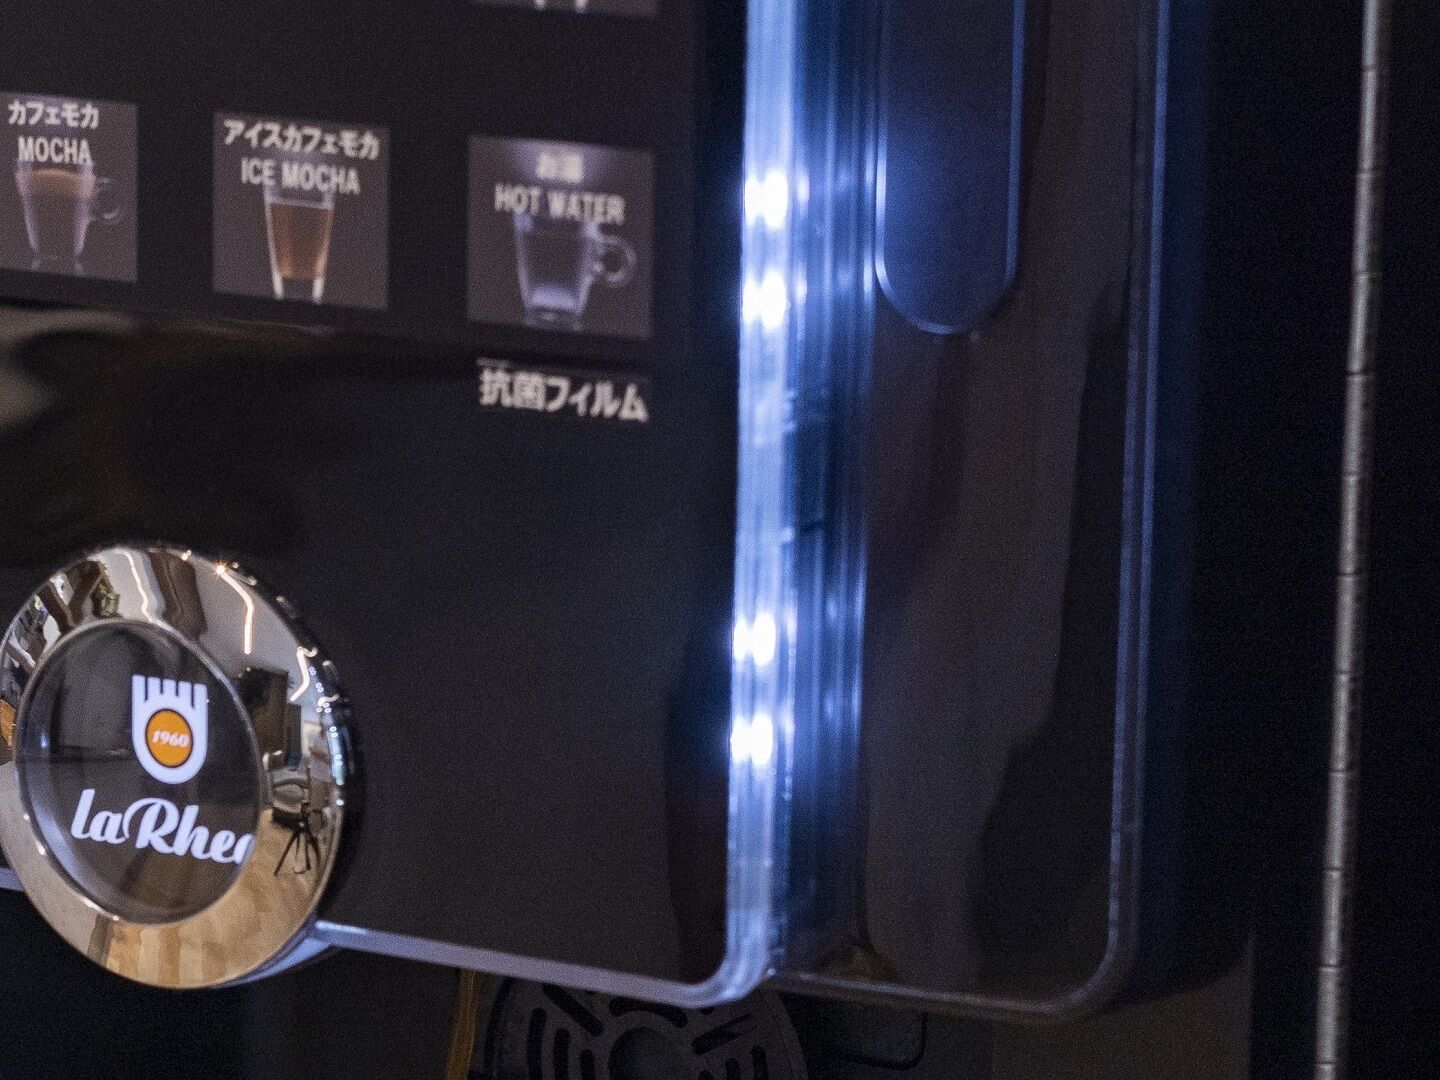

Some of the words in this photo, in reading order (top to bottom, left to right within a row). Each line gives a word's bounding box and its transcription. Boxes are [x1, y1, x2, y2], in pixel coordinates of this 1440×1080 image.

[7, 100, 100, 129] カフェモカ
[17, 136, 93, 164] MOCHA
[223, 118, 380, 160] アイスカフェモカ
[241, 157, 276, 186] ICE
[281, 161, 360, 195] MOCHA
[494, 182, 541, 214] HOT
[547, 189, 626, 225] WATER
[478, 368, 650, 423] 抗菌フィルム
[152, 730, 190, 748] 1960
